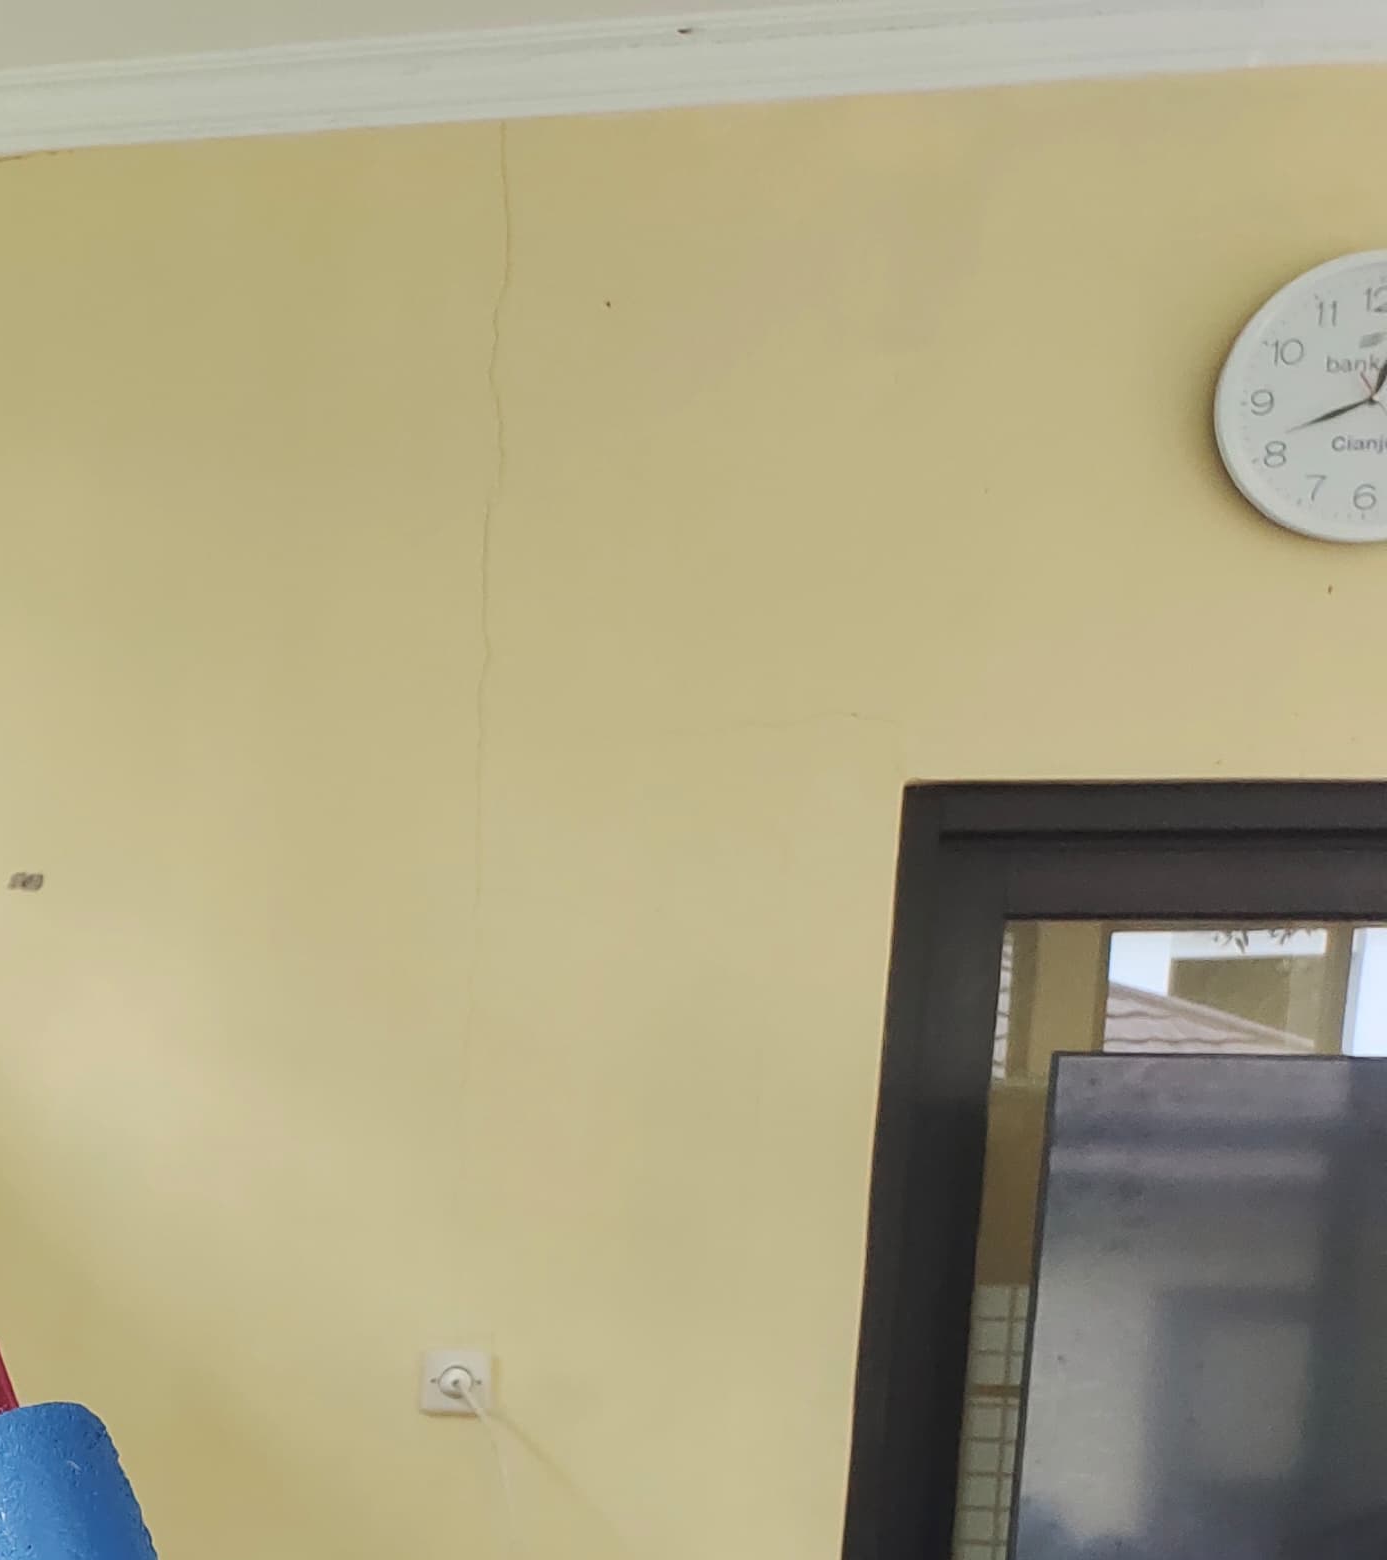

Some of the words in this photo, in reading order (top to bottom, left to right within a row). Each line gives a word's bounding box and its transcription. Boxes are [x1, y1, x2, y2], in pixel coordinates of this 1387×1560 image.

[1250, 389, 1274, 416] 9
[1263, 440, 1287, 469] 8
[1331, 434, 1387, 454] Cianj
[1305, 474, 1327, 501] 7
[1353, 484, 1377, 511] 6
